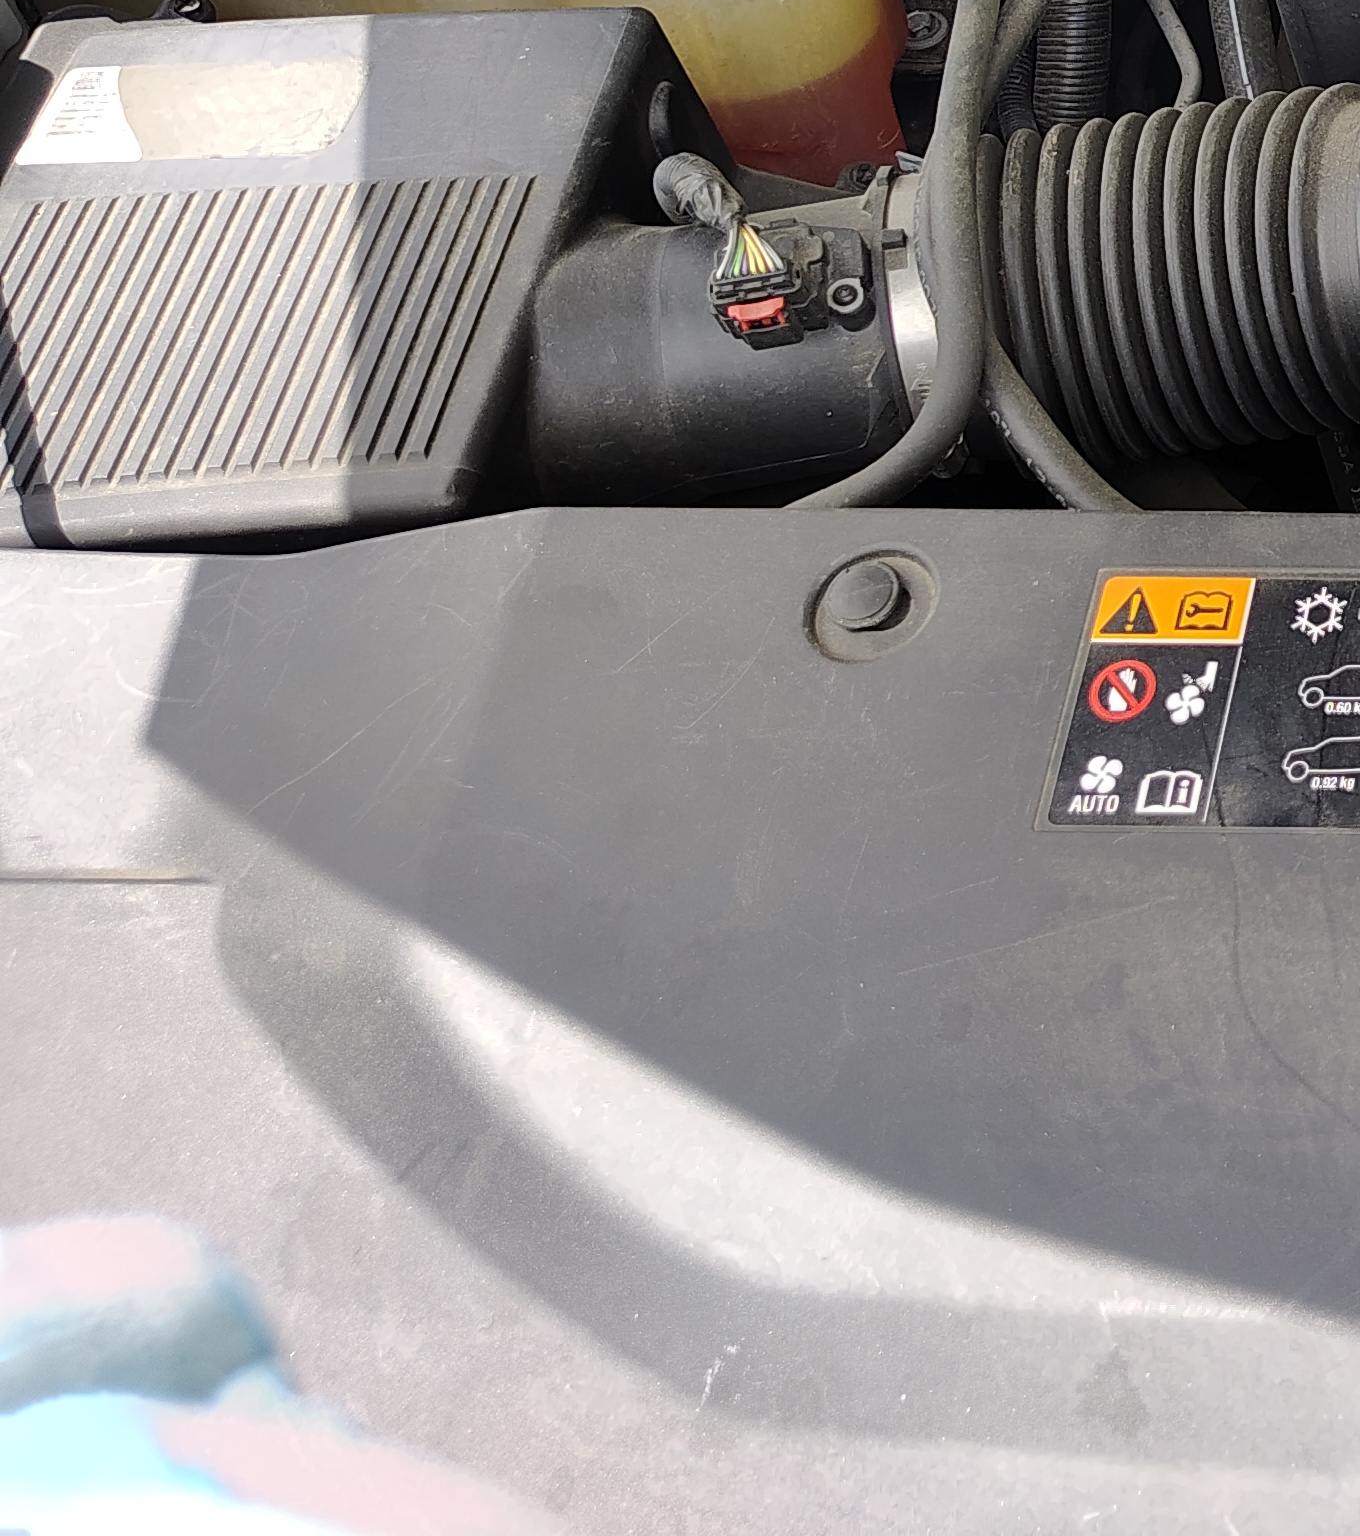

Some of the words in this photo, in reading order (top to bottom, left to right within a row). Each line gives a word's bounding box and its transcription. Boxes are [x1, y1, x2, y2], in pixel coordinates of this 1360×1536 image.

[1325, 702, 1351, 714] 0.60
[1311, 777, 1337, 790] 0.92
[1339, 777, 1355, 792] kg
[1068, 794, 1120, 813] AUTO
